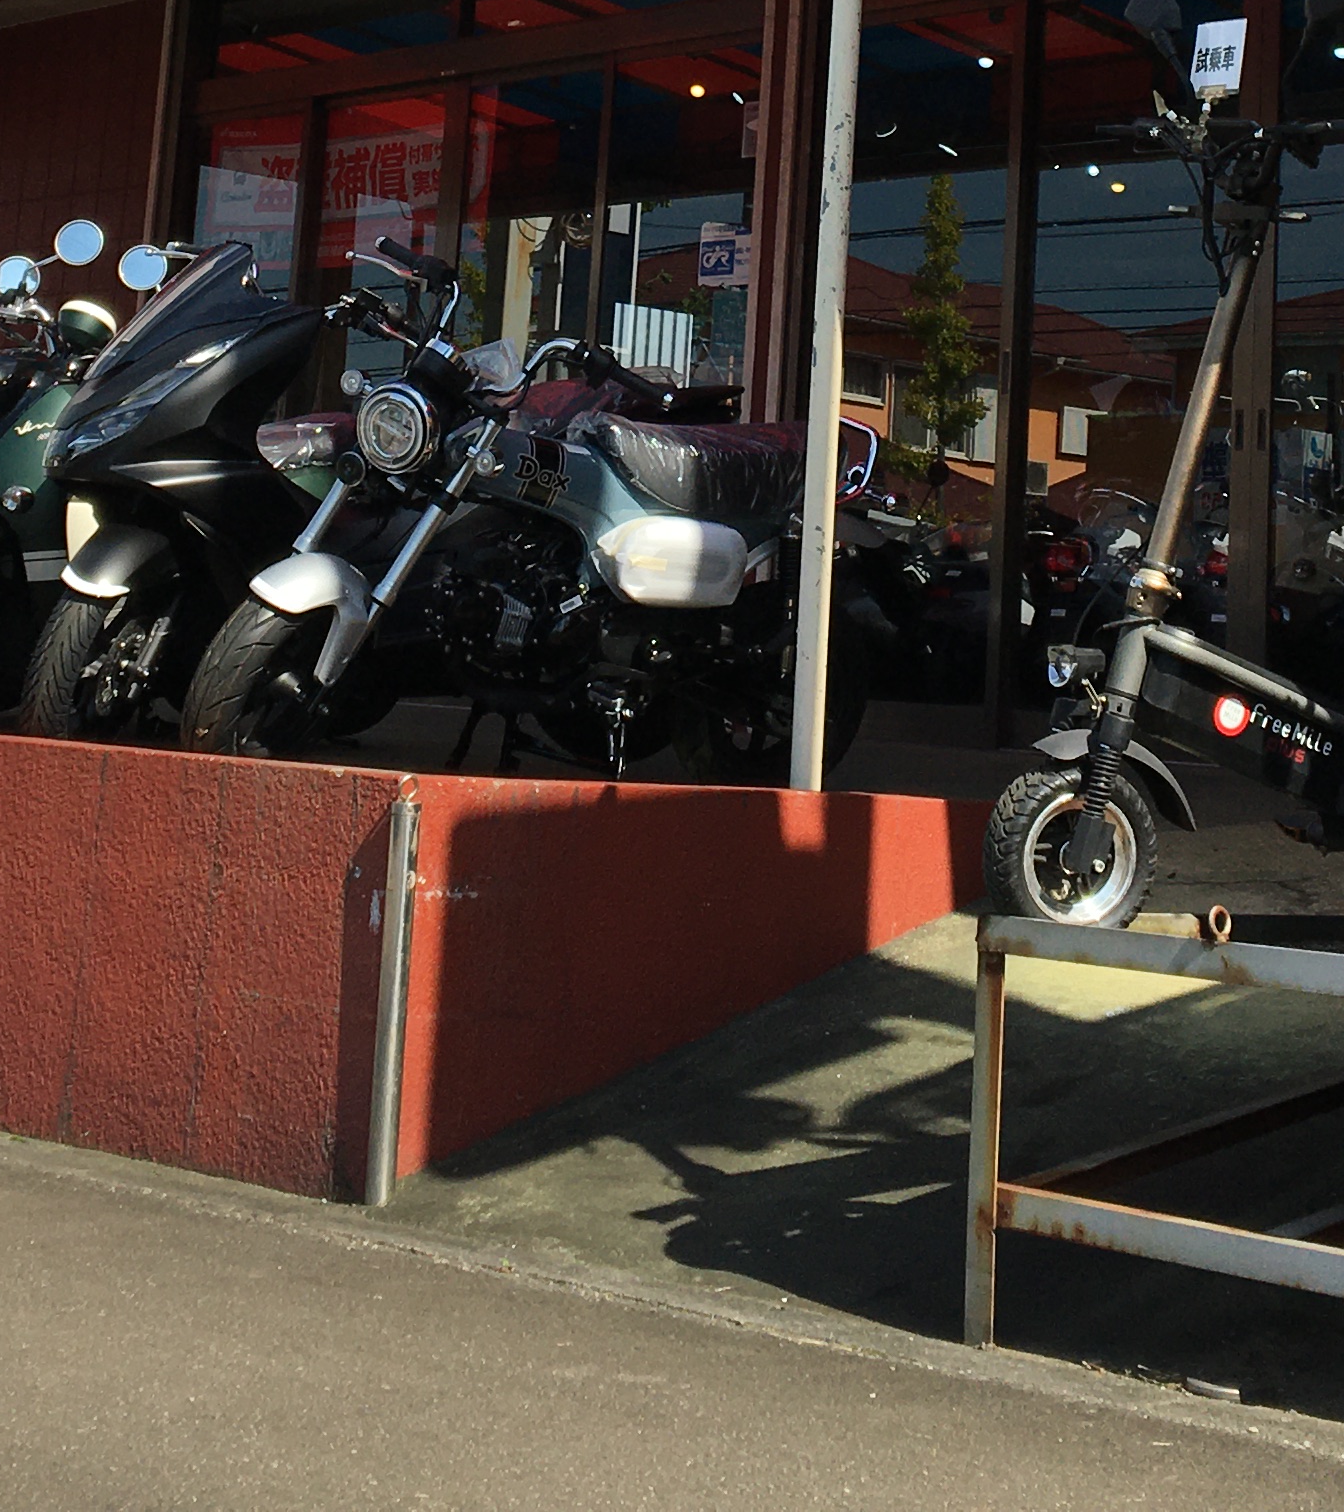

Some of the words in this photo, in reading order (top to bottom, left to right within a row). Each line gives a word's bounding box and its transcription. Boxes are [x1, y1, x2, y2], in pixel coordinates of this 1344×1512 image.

[1195, 44, 1237, 73] 試乗車
[512, 452, 572, 492] Dax
